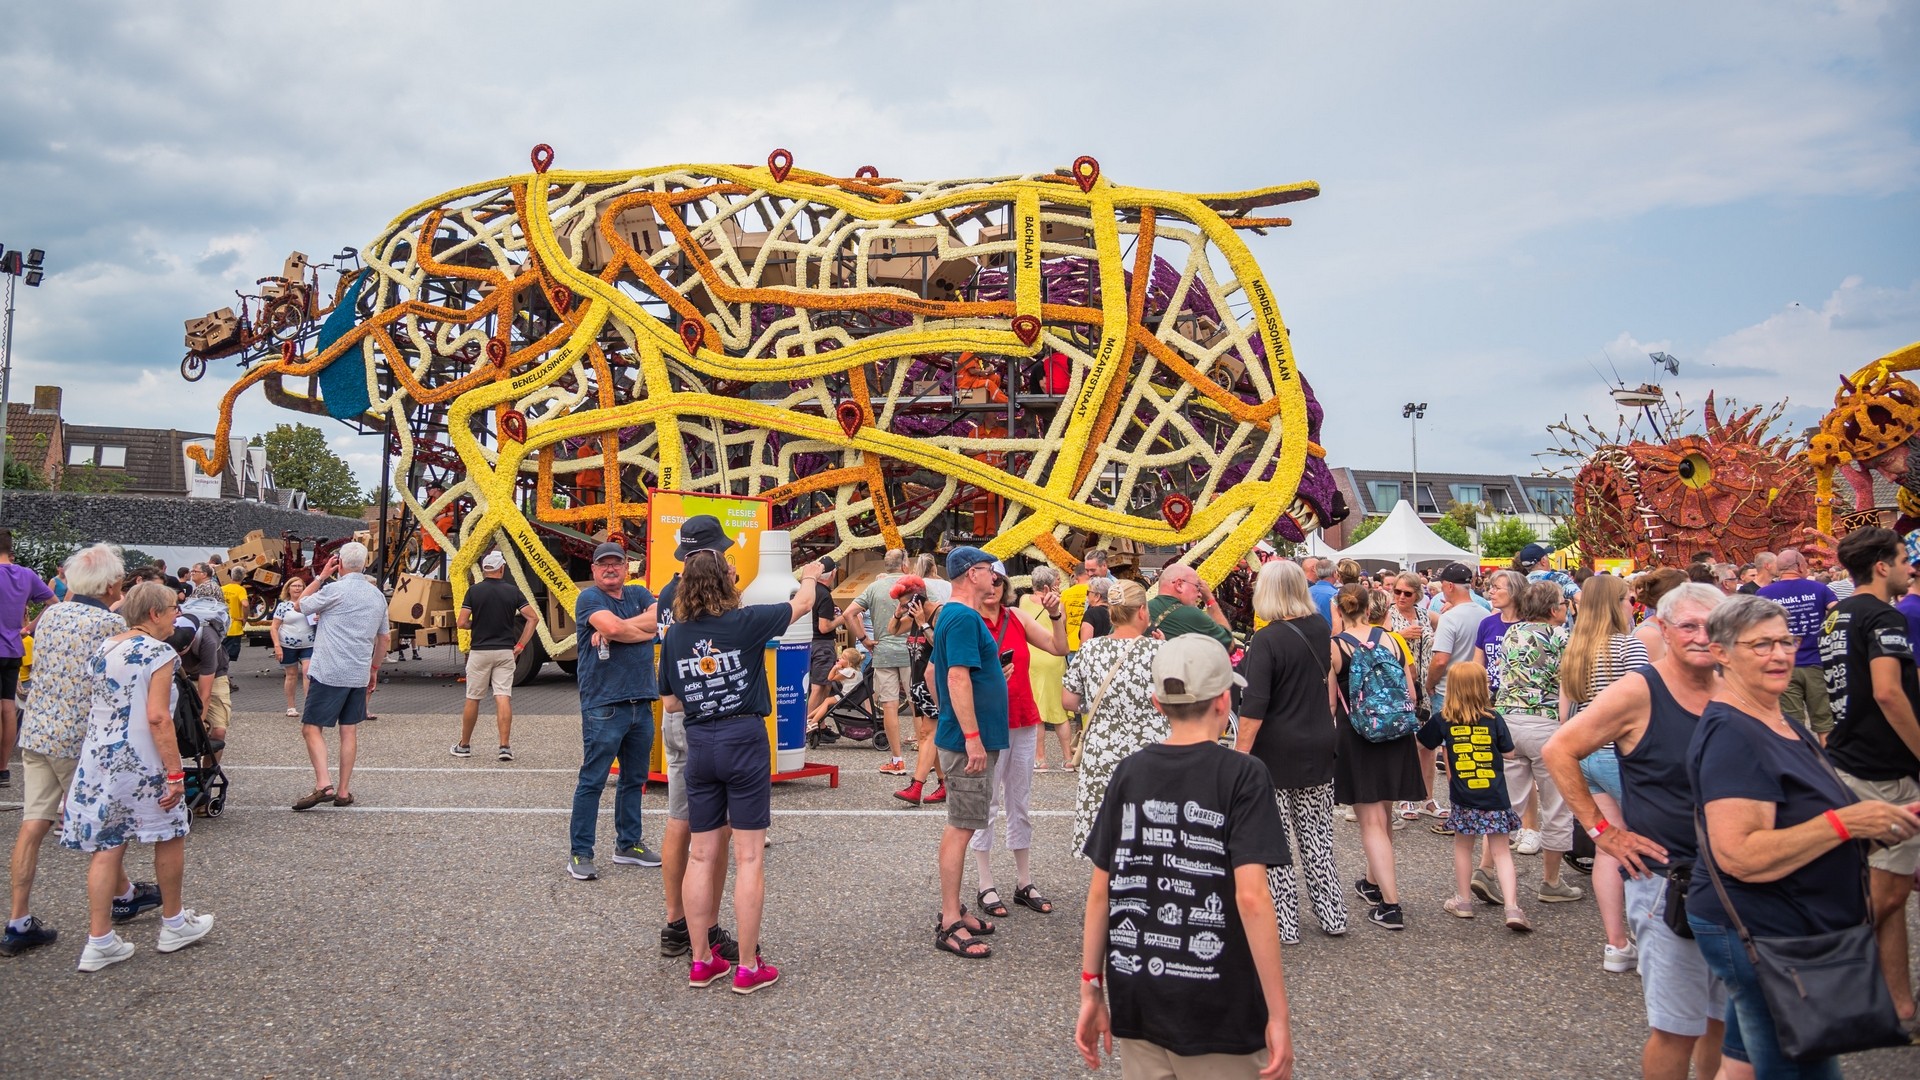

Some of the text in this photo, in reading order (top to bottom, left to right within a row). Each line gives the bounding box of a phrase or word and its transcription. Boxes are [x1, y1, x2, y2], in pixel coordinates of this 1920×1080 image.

[1024, 215, 1035, 269] BACHLAAN
[896, 297, 946, 311] SCHUBERTWEG
[1251, 279, 1291, 381] MENDELSSOHNLAAN
[512, 347, 573, 390] BENELUXSINGEL
[1078, 337, 1115, 418] MOZARTSTRAAT
[663, 466, 672, 490] BRA
[727, 508, 757, 518] FLESJES
[874, 489, 891, 527] LISZTLAAN
[660, 515, 691, 524] RESTAF
[731, 519, 759, 529] BLIKJES
[518, 530, 568, 593] VIVALDISTRAAT
[1801, 593, 1816, 602] thx!
[1142, 827, 1177, 843] NED.
[1142, 840, 1174, 848] PERSONEEL
[1110, 873, 1147, 886] Jansen
[1171, 878, 1193, 889] JANUS
[1173, 885, 1196, 897] VATEN
[1189, 906, 1226, 922] Tenax
[1109, 928, 1138, 938] RENOVATIE
[1147, 934, 1180, 945] MEIJER
[1164, 968, 1221, 981] muurschilderingen
